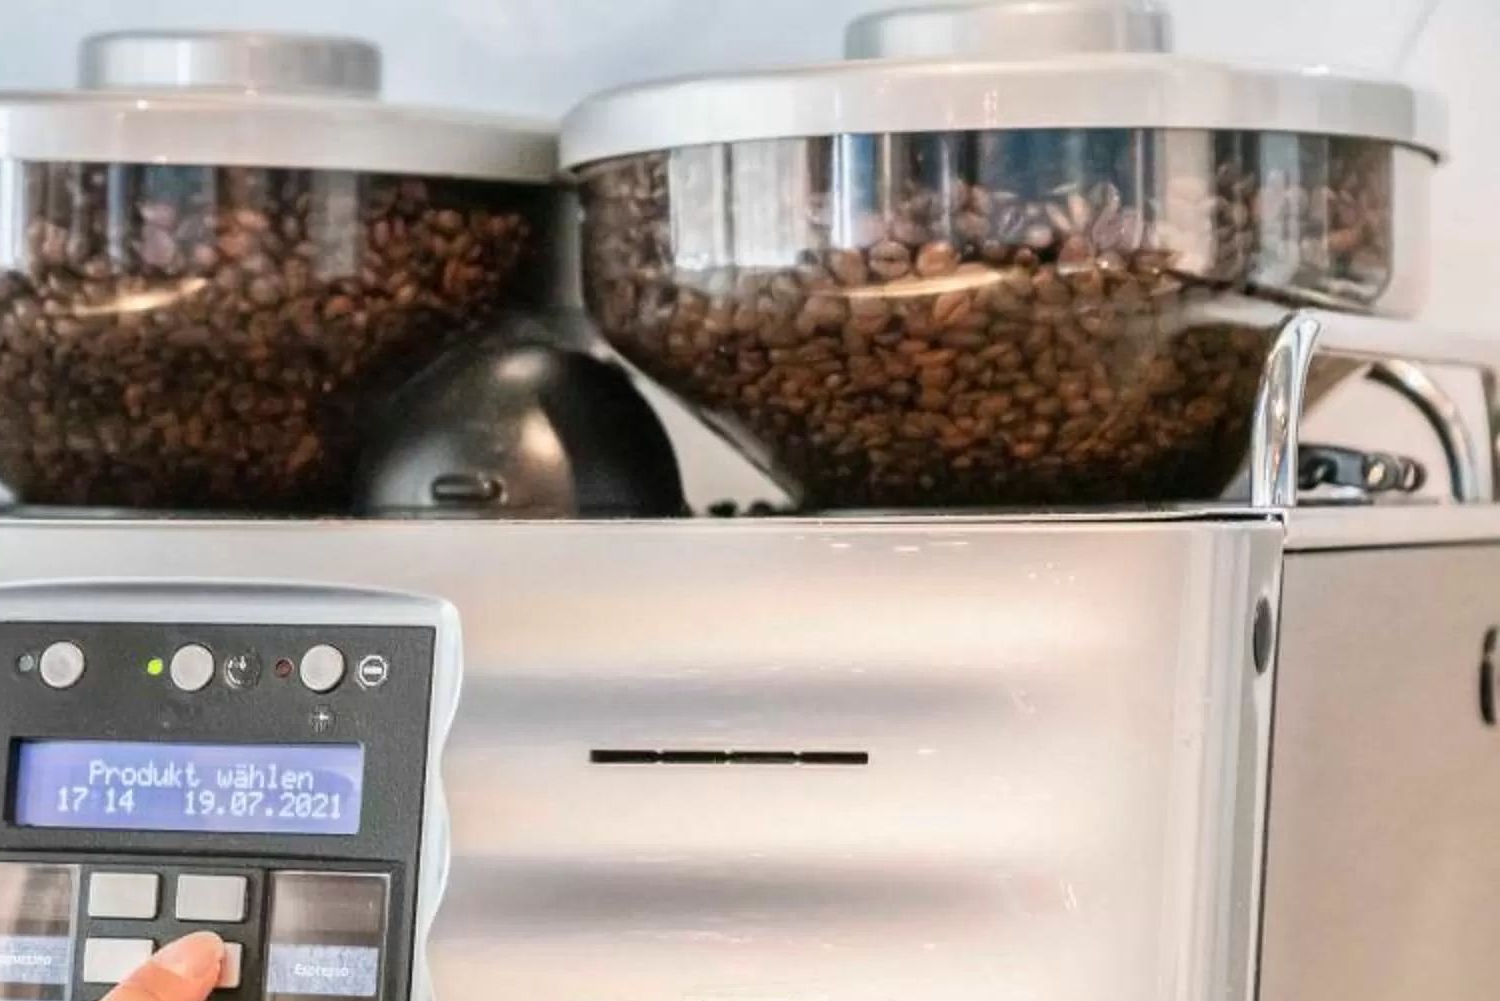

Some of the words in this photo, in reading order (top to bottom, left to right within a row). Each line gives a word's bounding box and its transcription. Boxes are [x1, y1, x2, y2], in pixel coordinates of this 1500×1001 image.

[89, 760, 202, 787] Produkt
[217, 763, 314, 790] wählen
[184, 790, 341, 819] 19.07.2021
